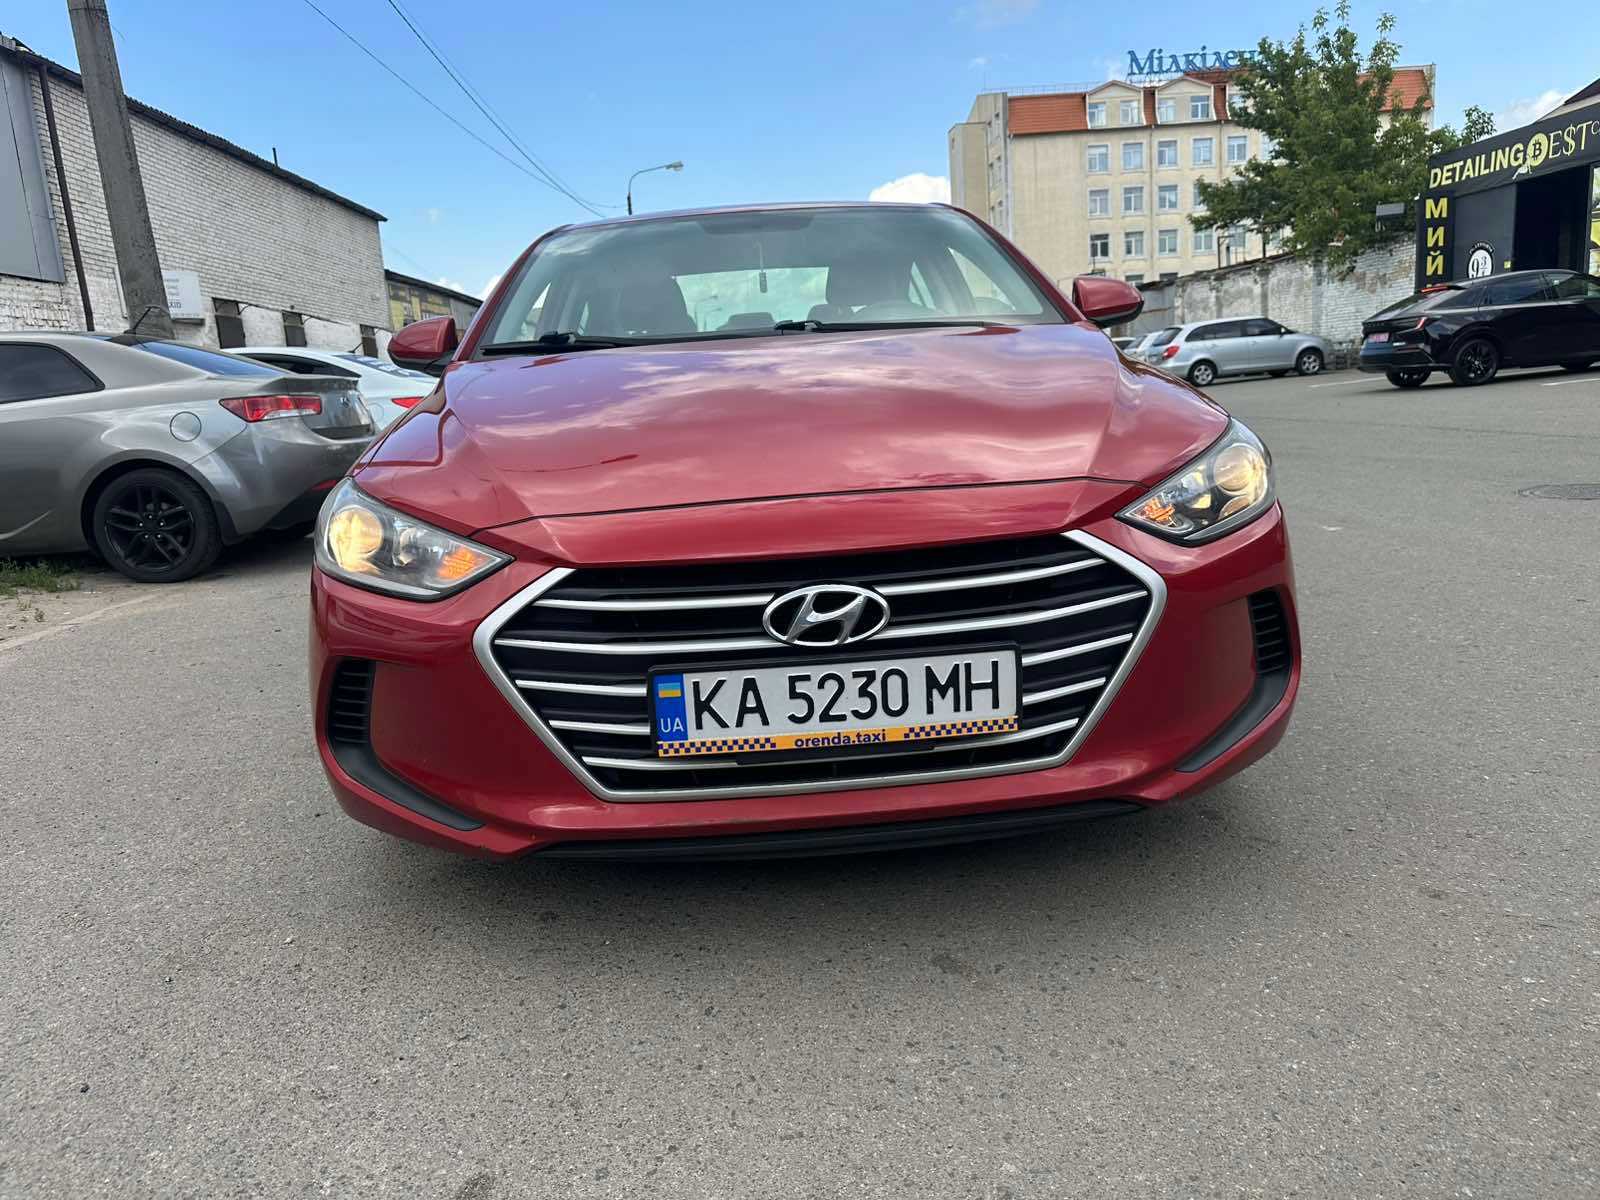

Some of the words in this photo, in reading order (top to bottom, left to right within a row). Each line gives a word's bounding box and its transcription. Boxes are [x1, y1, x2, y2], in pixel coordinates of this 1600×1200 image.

[1127, 45, 1258, 76] Мілкілен
[1429, 143, 1523, 189] DETAILING
[1425, 198, 1448, 287] МИЙ
[660, 717, 684, 733] UA
[693, 677, 770, 730] KA
[788, 668, 909, 723] 5230
[924, 661, 999, 714] MH
[794, 729, 887, 748] orenda.taxi
